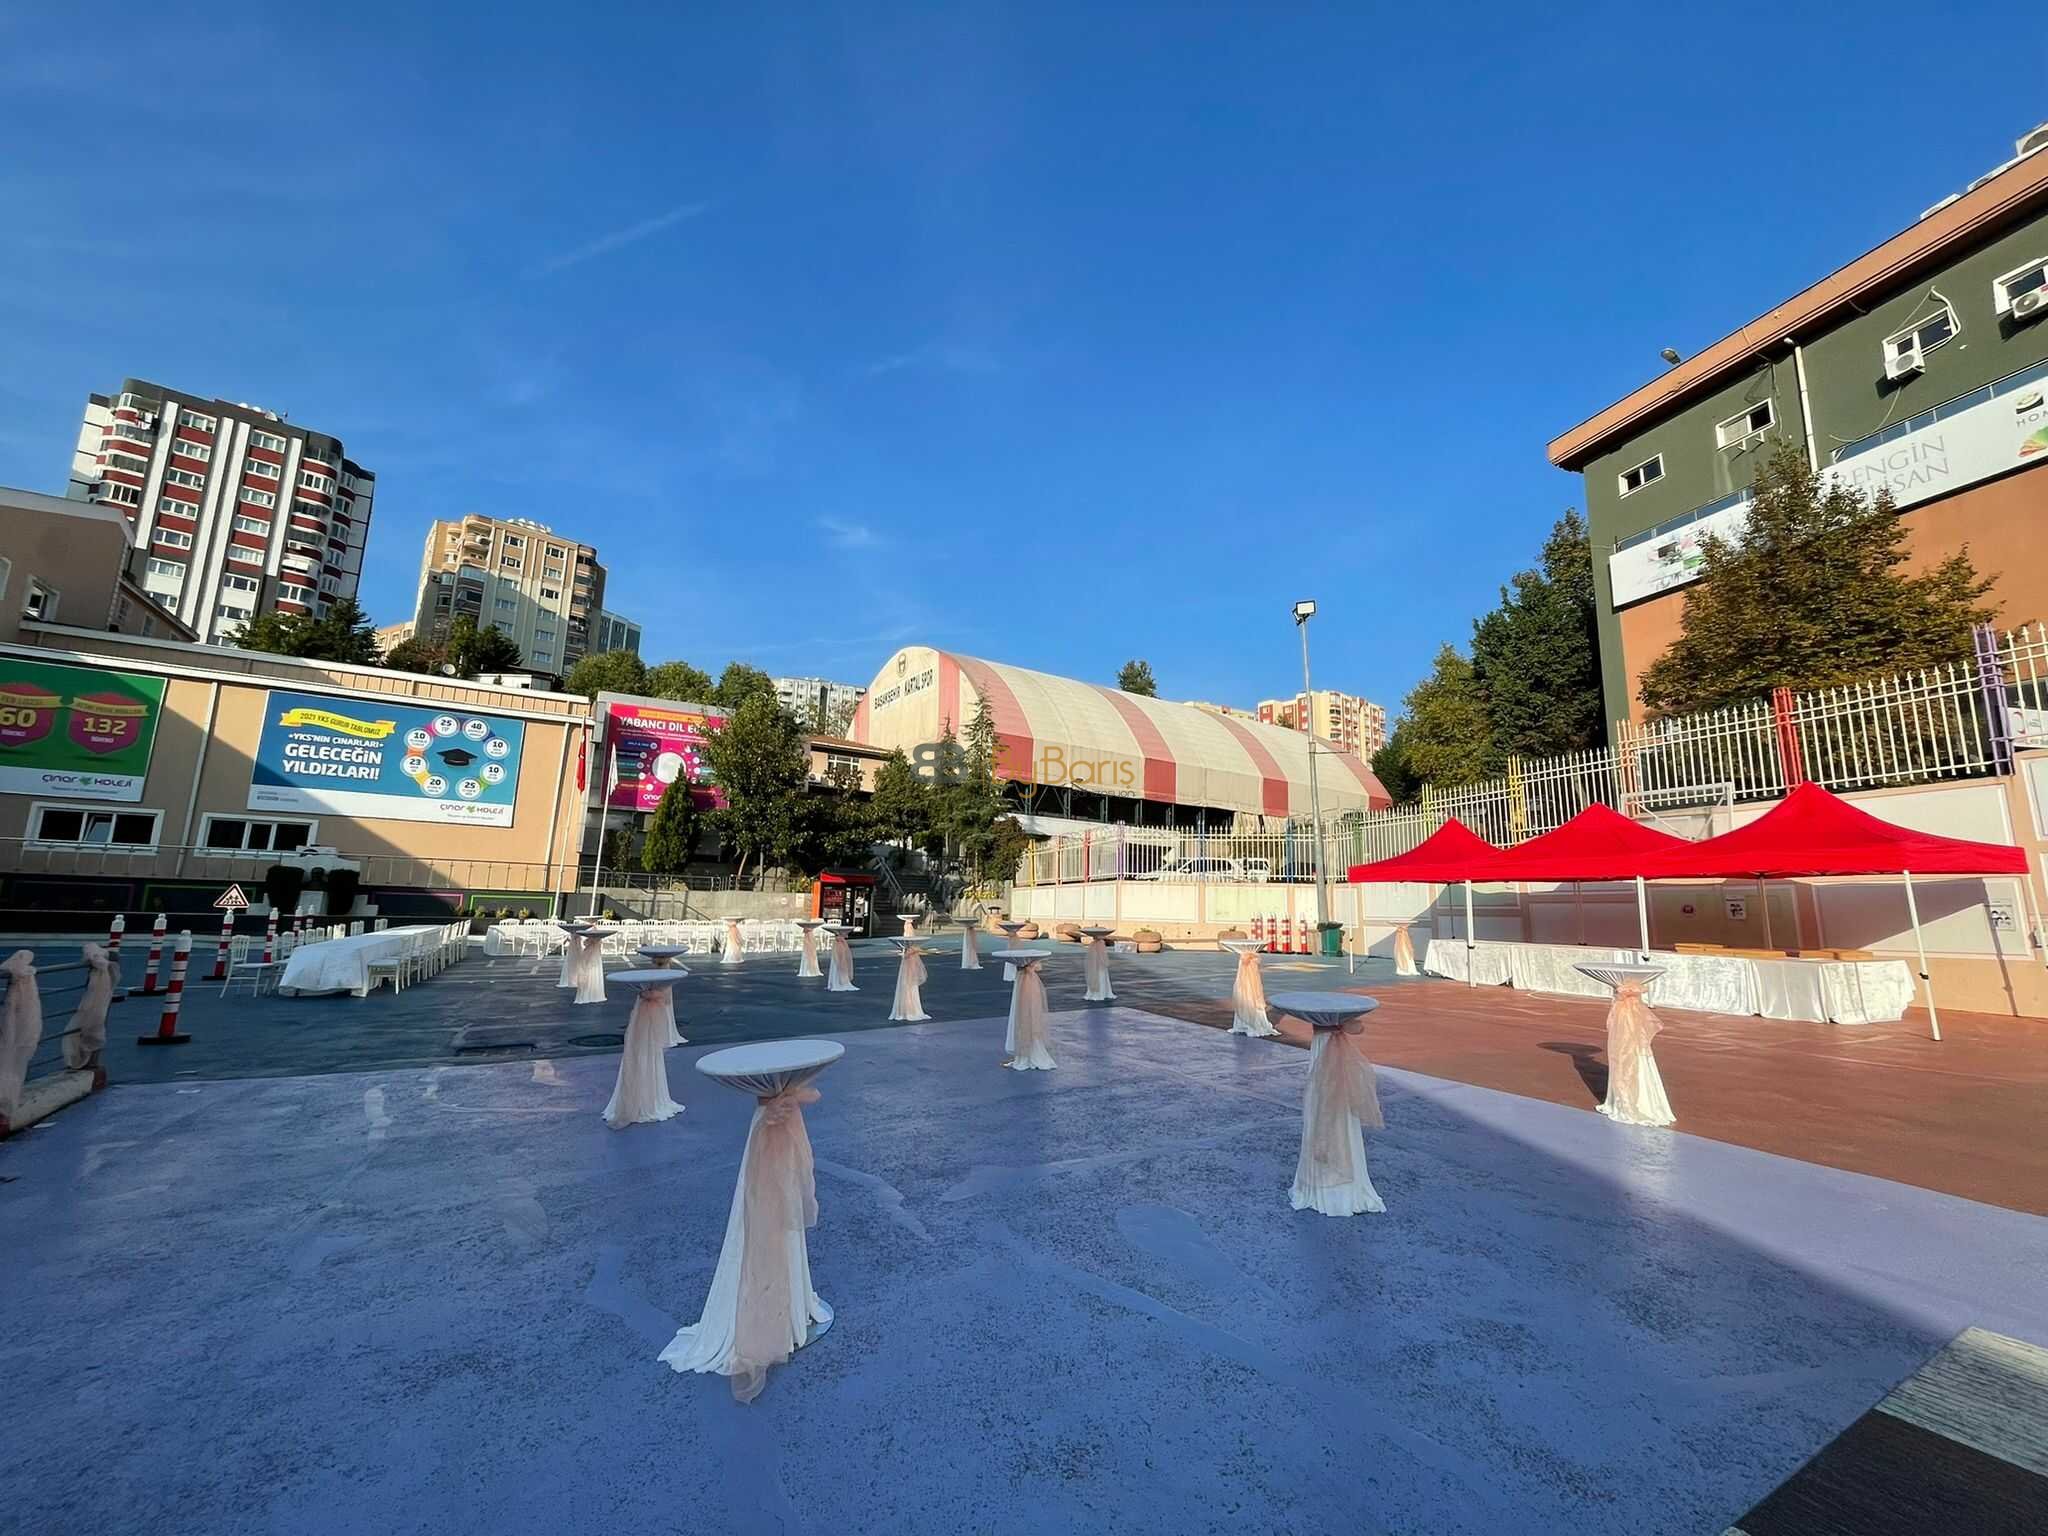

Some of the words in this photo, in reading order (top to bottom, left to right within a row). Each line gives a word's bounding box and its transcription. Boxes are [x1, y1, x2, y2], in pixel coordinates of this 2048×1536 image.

[0, 706, 37, 728] 60
[82, 717, 128, 736] 132
[620, 716, 666, 730] YABANCI
[282, 760, 380, 780] YILDIZLARI!
